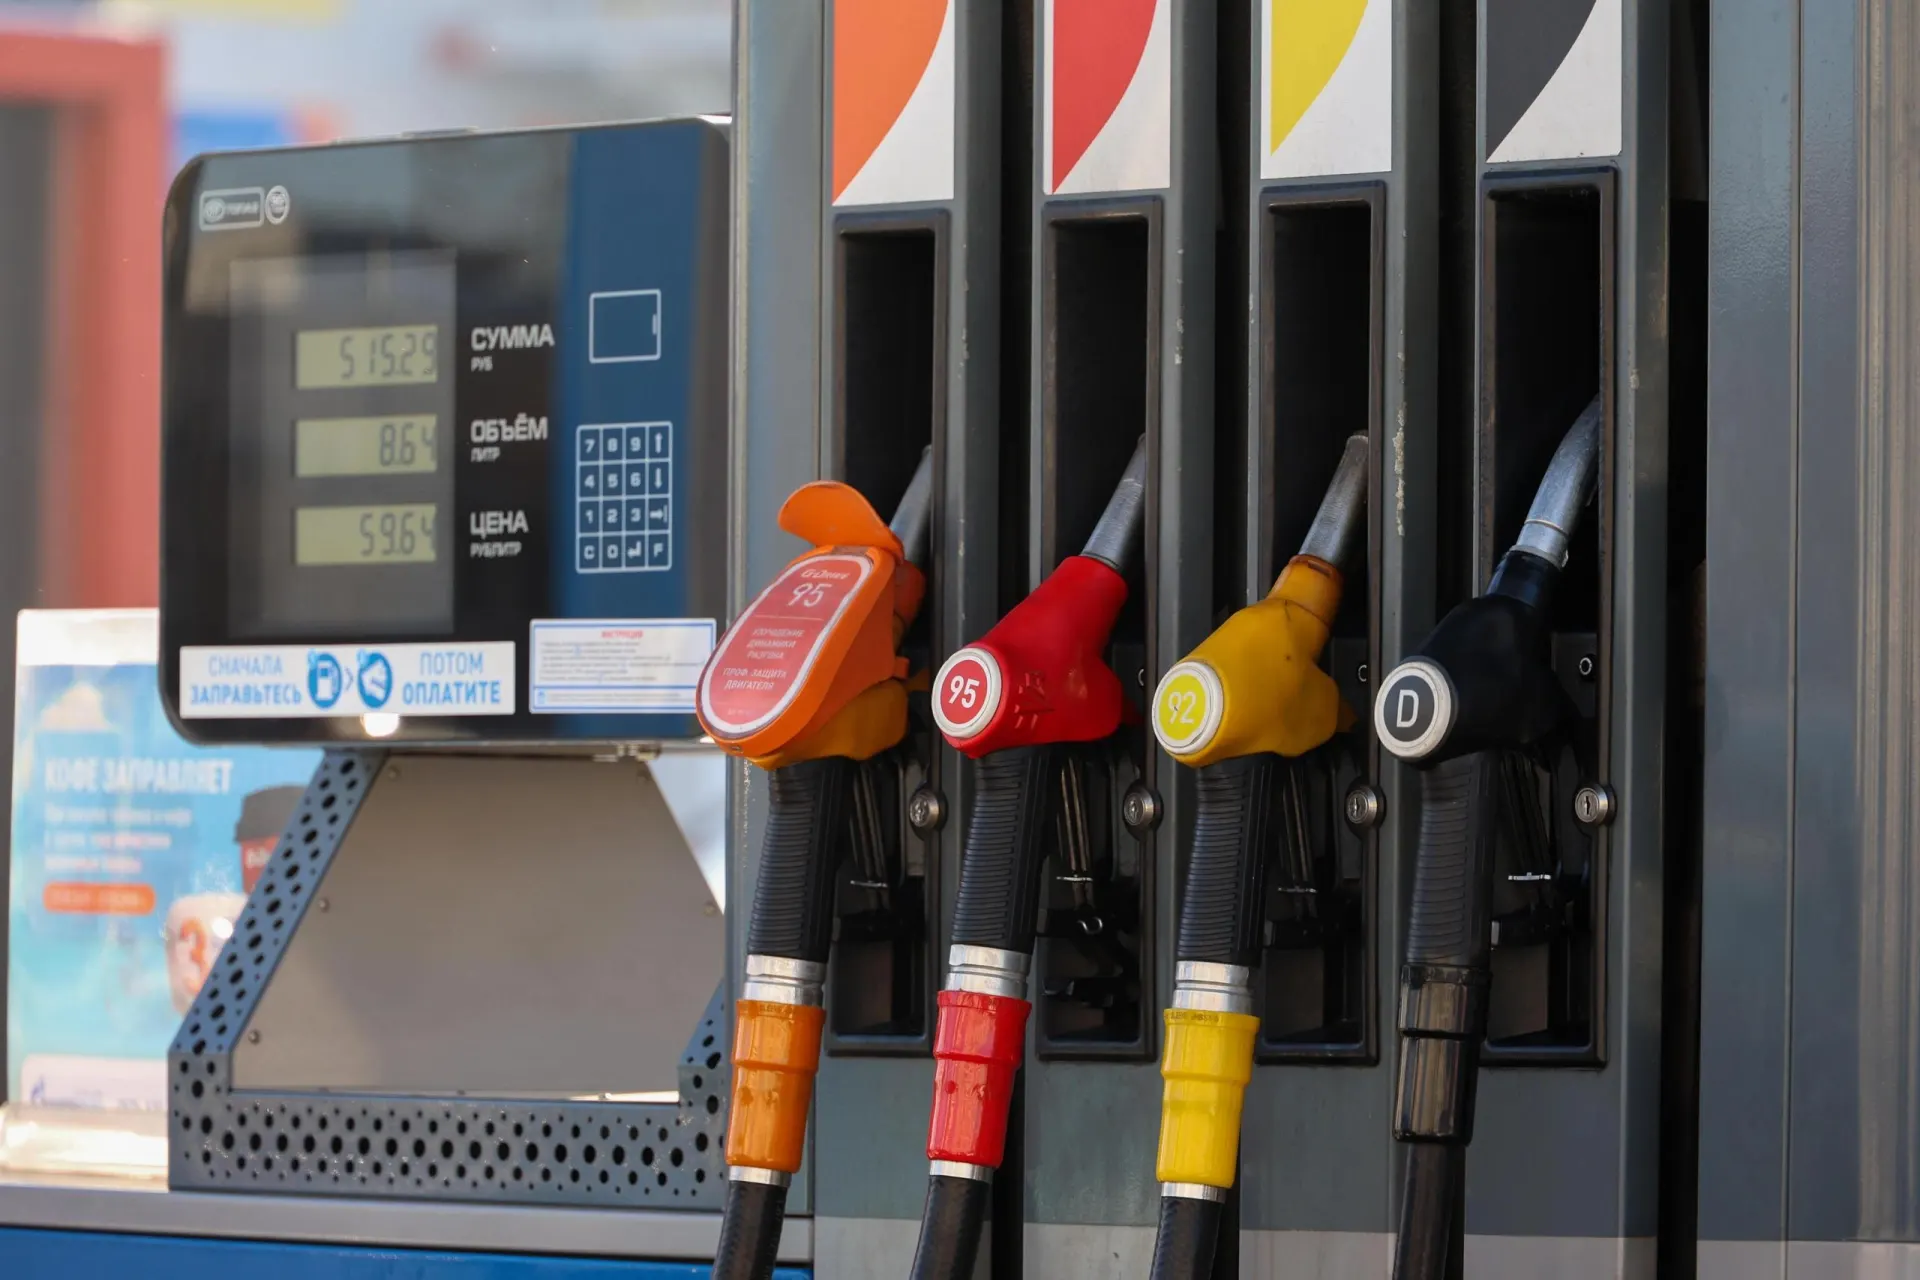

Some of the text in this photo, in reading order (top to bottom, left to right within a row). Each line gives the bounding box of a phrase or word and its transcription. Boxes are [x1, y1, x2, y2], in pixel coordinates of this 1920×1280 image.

[471, 324, 555, 351] СУММА
[471, 356, 493, 372] РУБ
[471, 412, 548, 443] ОБЪЁМ
[584, 436, 641, 453] 7 8 9
[584, 472, 641, 488] 4 5 6
[470, 509, 529, 539] ЦЕНА
[585, 507, 641, 524] 1 2 3
[653, 543, 664, 558] F
[787, 582, 833, 608] 95
[208, 654, 283, 677] СНАЧАЛА
[420, 652, 484, 676] ПОТОМ
[751, 668, 787, 679] ЗАЩИТА
[190, 683, 302, 706] ЗАПРАВЬТЕСЬ
[402, 680, 501, 706] ОПЛАТИТЕ
[724, 680, 775, 691] ДВИГАТЕЛЯ
[948, 675, 980, 709] 95
[1168, 691, 1197, 725] 92
[1396, 689, 1419, 728] D
